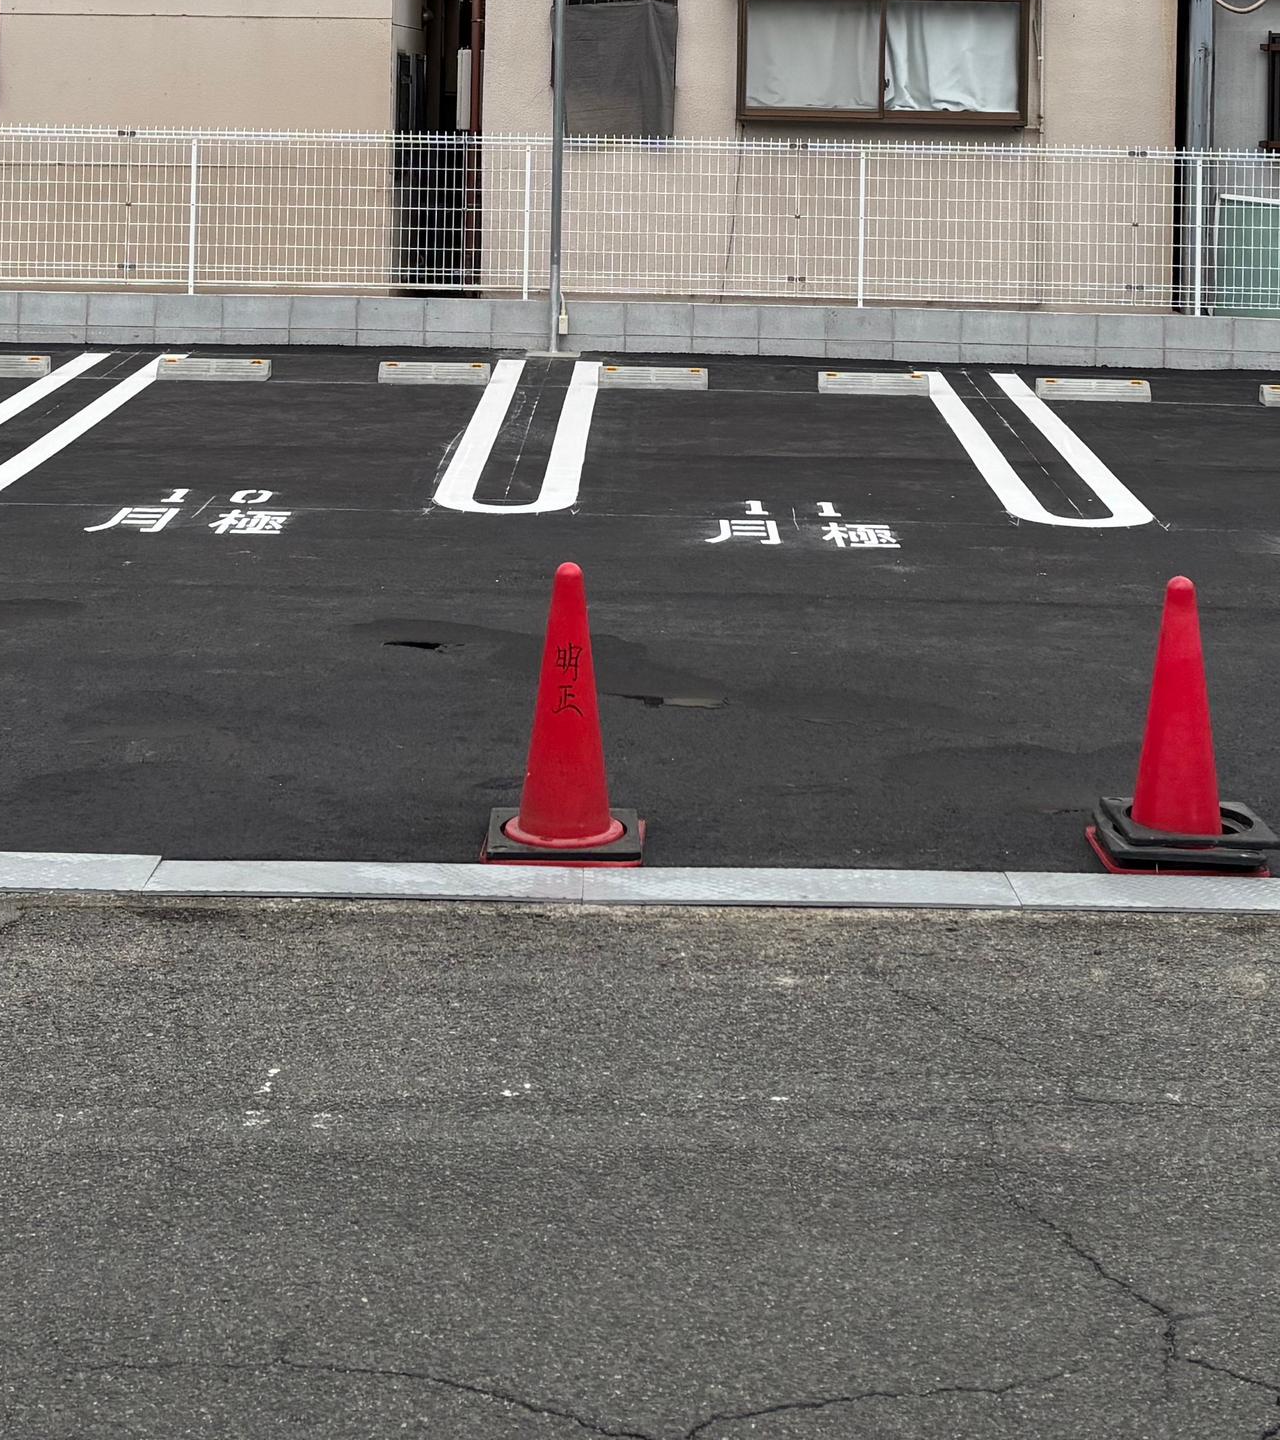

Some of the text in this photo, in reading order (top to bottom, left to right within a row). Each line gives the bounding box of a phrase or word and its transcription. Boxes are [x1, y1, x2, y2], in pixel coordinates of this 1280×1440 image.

[160, 488, 273, 503] 10
[745, 500, 841, 517] 11
[83, 508, 292, 534] 月極
[704, 519, 901, 548] 月極
[553, 642, 583, 717] 明正
